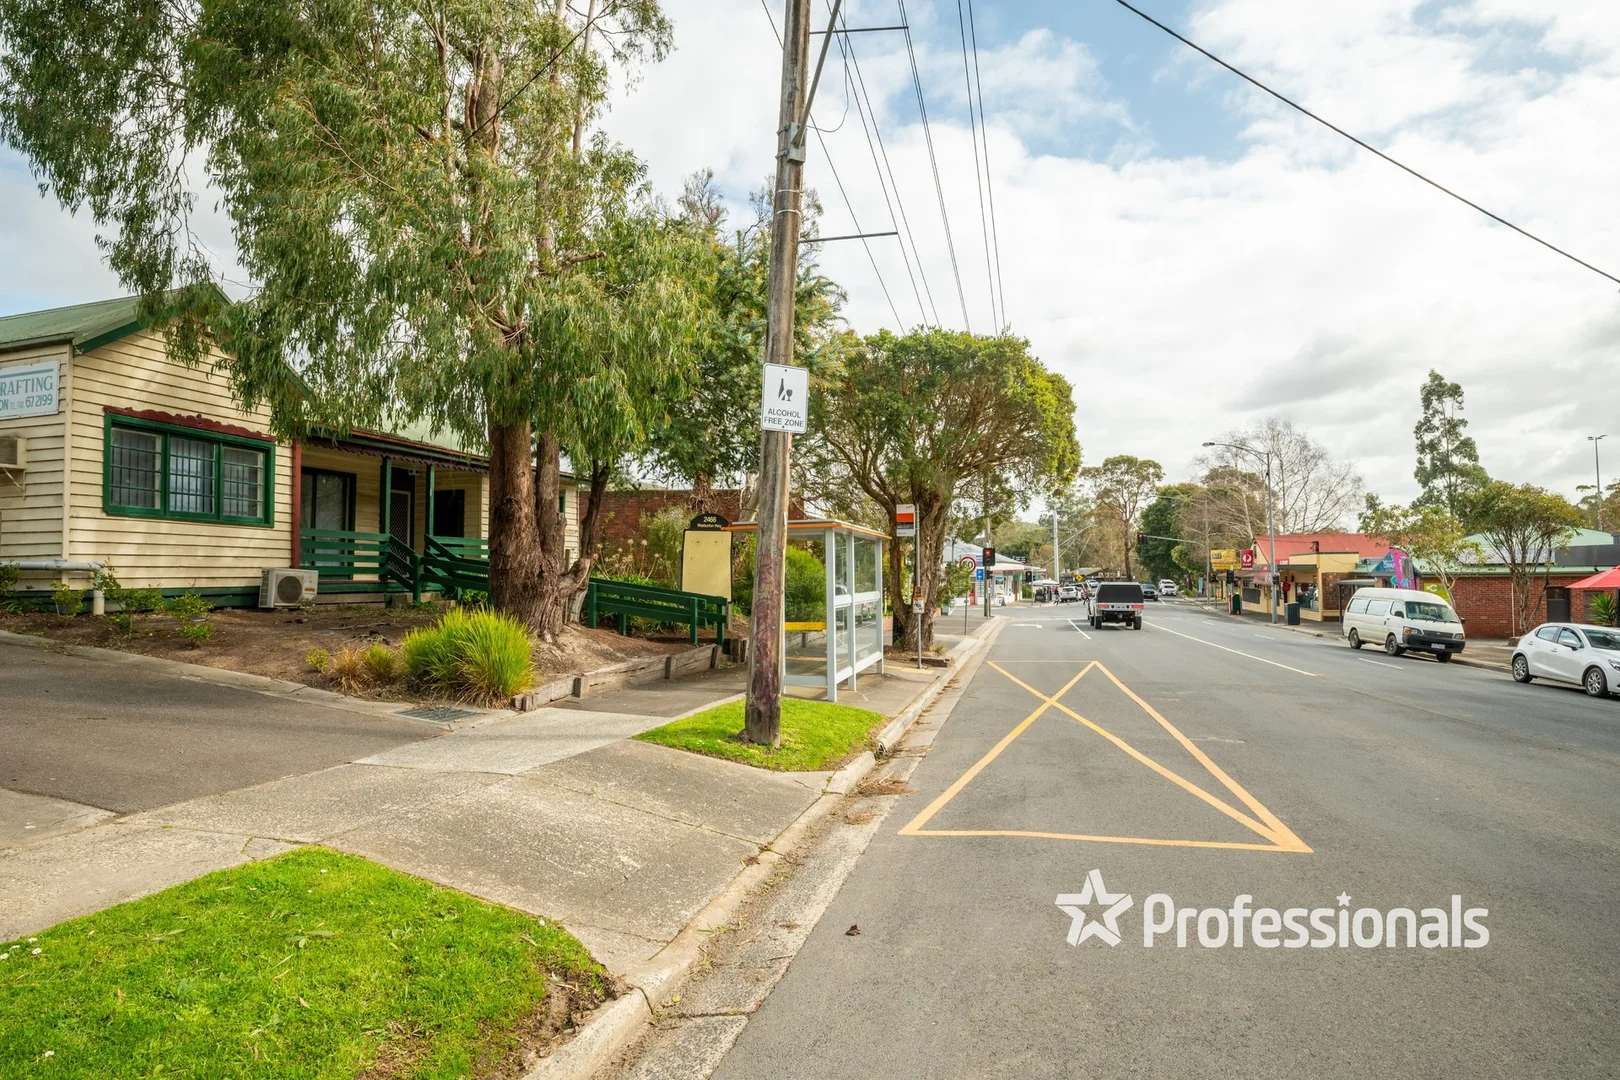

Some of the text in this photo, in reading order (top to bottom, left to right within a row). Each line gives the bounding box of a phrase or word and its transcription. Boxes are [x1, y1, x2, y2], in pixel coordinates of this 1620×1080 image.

[768, 408, 801, 418] ALCOHOL
[764, 416, 804, 427] FREE ZONE
